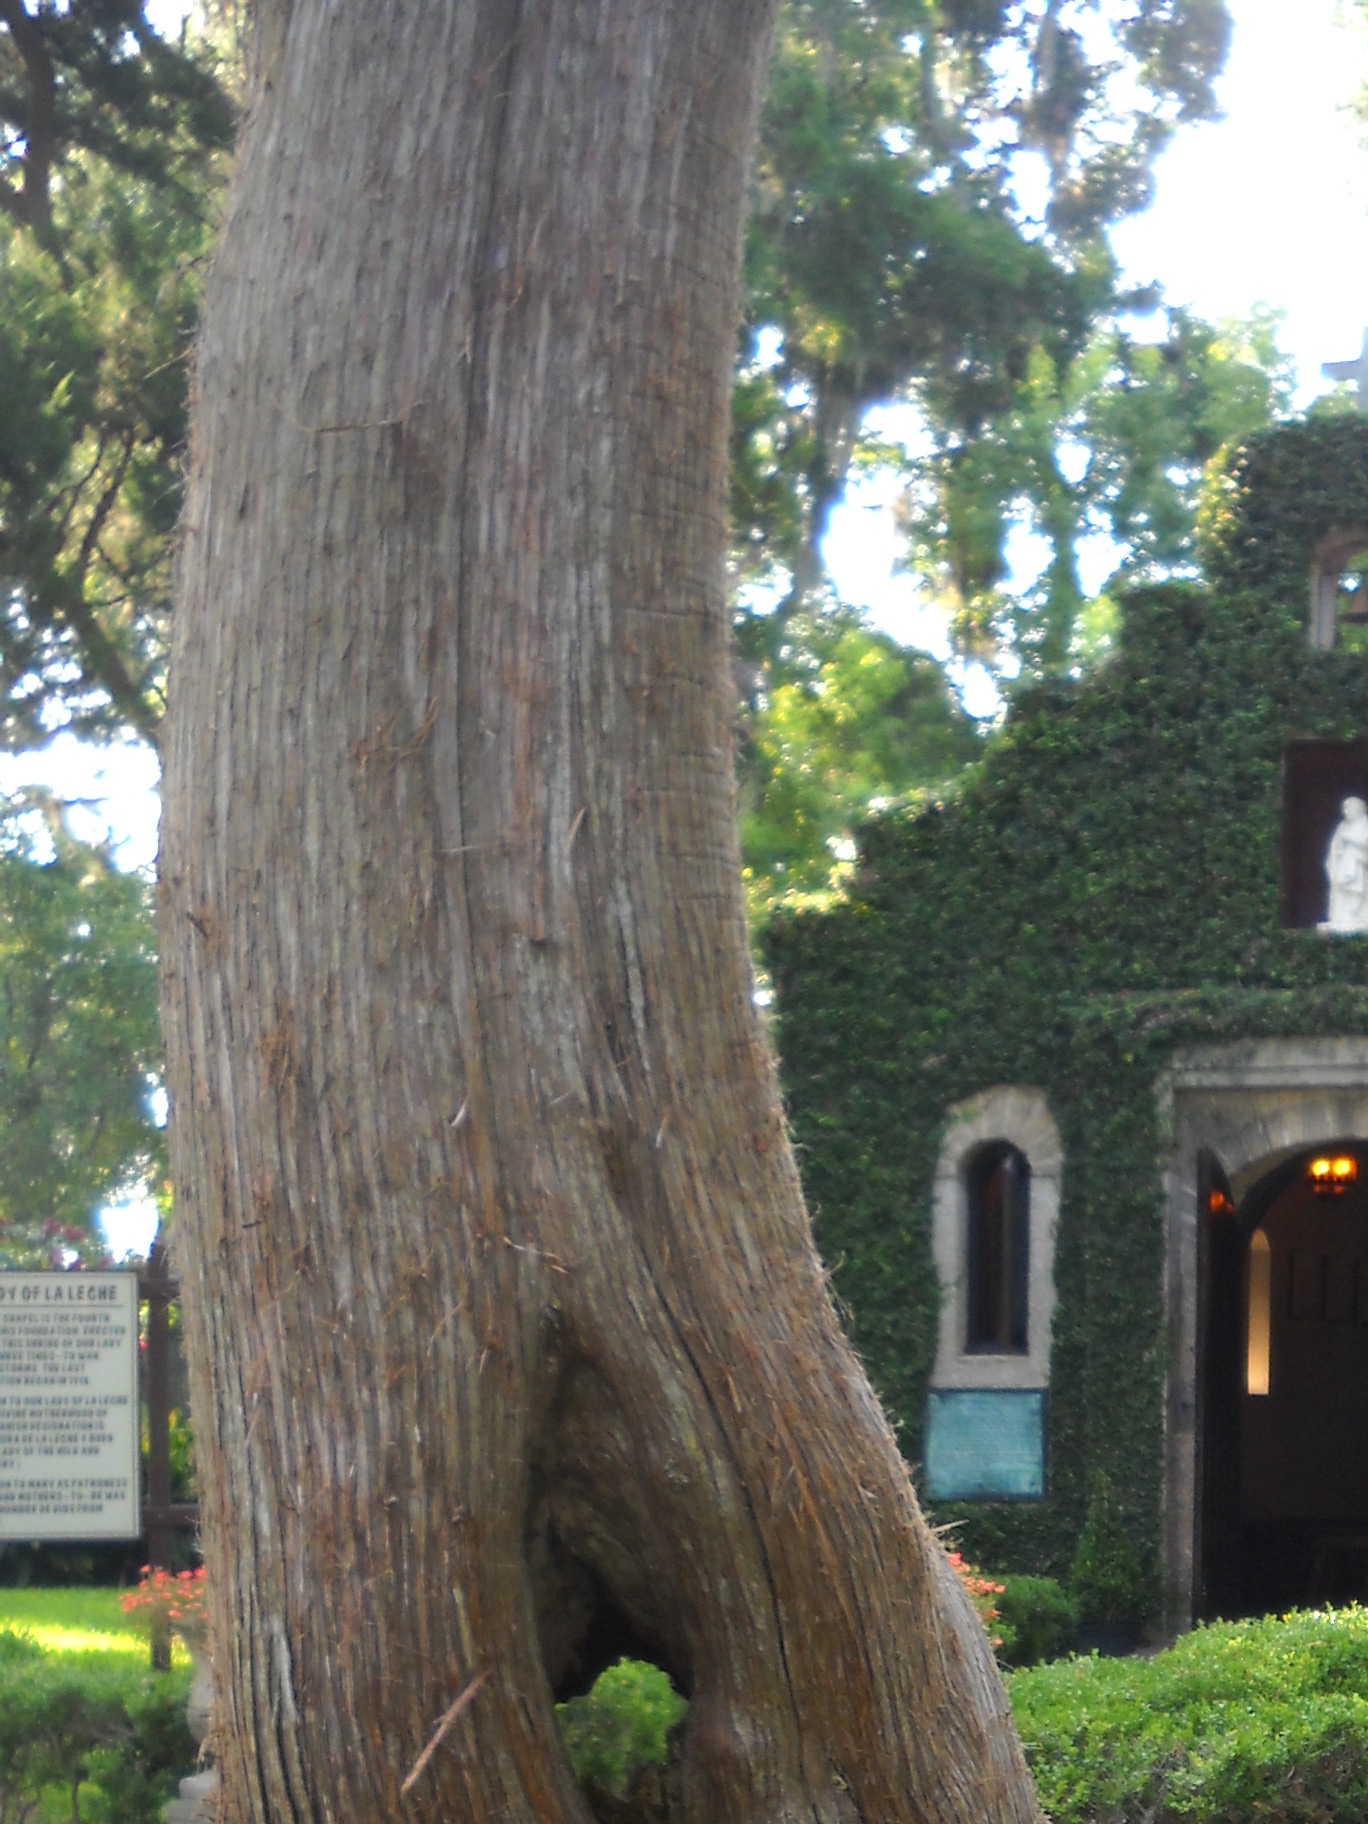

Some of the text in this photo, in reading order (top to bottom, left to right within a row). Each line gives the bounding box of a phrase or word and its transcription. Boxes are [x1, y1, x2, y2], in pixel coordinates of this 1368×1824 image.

[22, 1285, 39, 1300] OF
[45, 1285, 62, 1300] LA
[68, 1285, 117, 1300] LECHE
